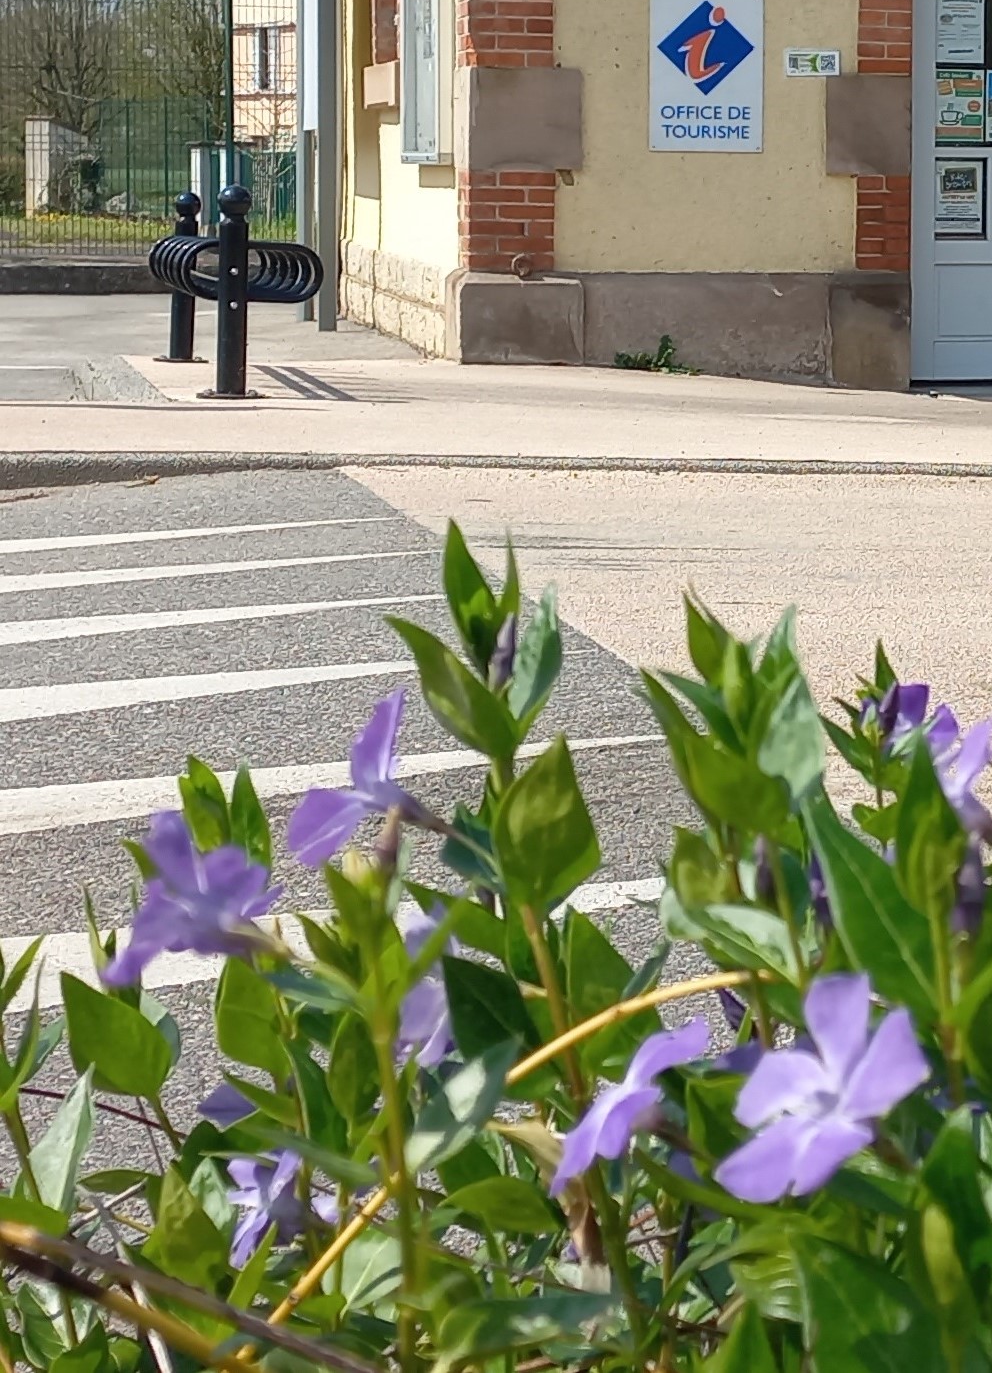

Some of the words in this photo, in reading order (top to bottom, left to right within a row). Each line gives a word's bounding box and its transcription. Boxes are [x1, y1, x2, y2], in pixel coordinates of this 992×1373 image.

[660, 105, 722, 120] OFFICE
[728, 106, 751, 120] DE
[661, 125, 750, 140] TOURISME
